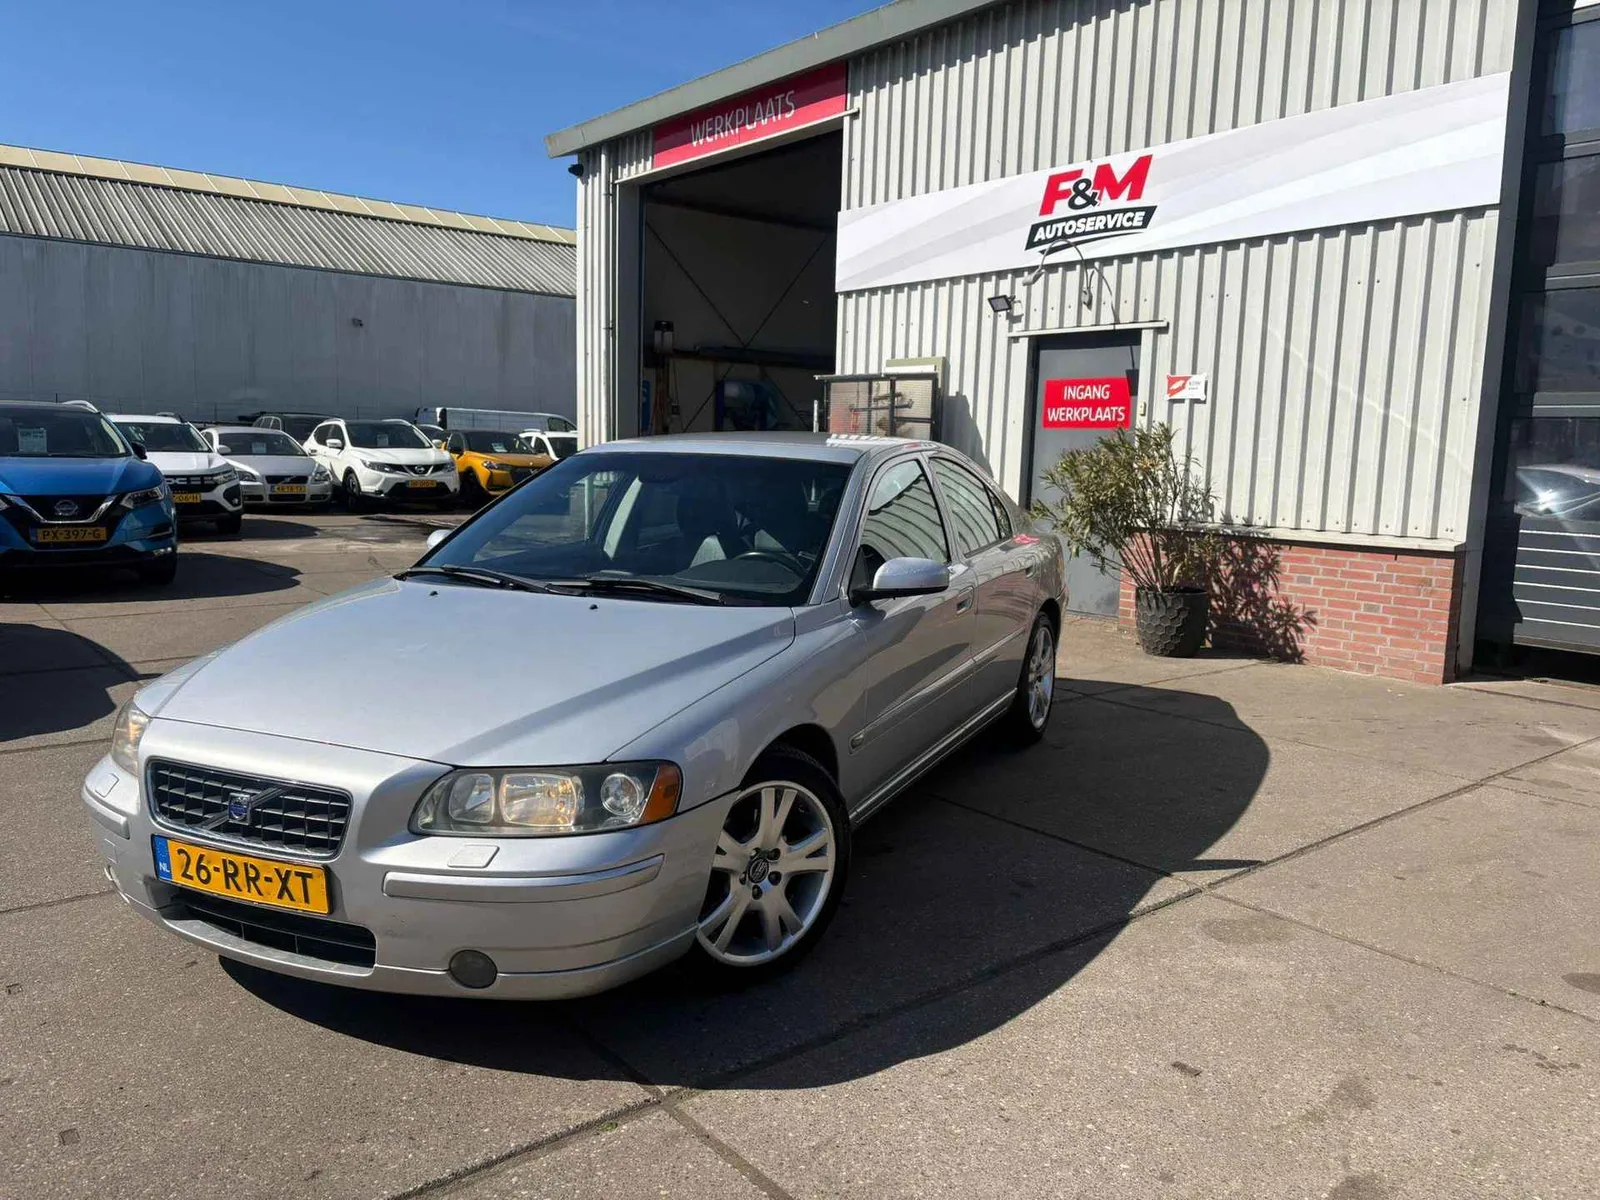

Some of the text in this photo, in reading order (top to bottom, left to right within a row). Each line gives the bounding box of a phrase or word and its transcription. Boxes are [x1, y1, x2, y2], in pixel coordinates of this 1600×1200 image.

[690, 90, 796, 147] WERKPLAATS
[1039, 154, 1153, 216] F&M
[1033, 211, 1146, 242] AUTOSERVICE
[1063, 384, 1111, 400] INGANG
[1047, 406, 1126, 422] WERKPLAATS
[42, 529, 101, 541] PX-397-G
[159, 861, 171, 873] NL
[177, 848, 314, 905] 26-RR-XT
